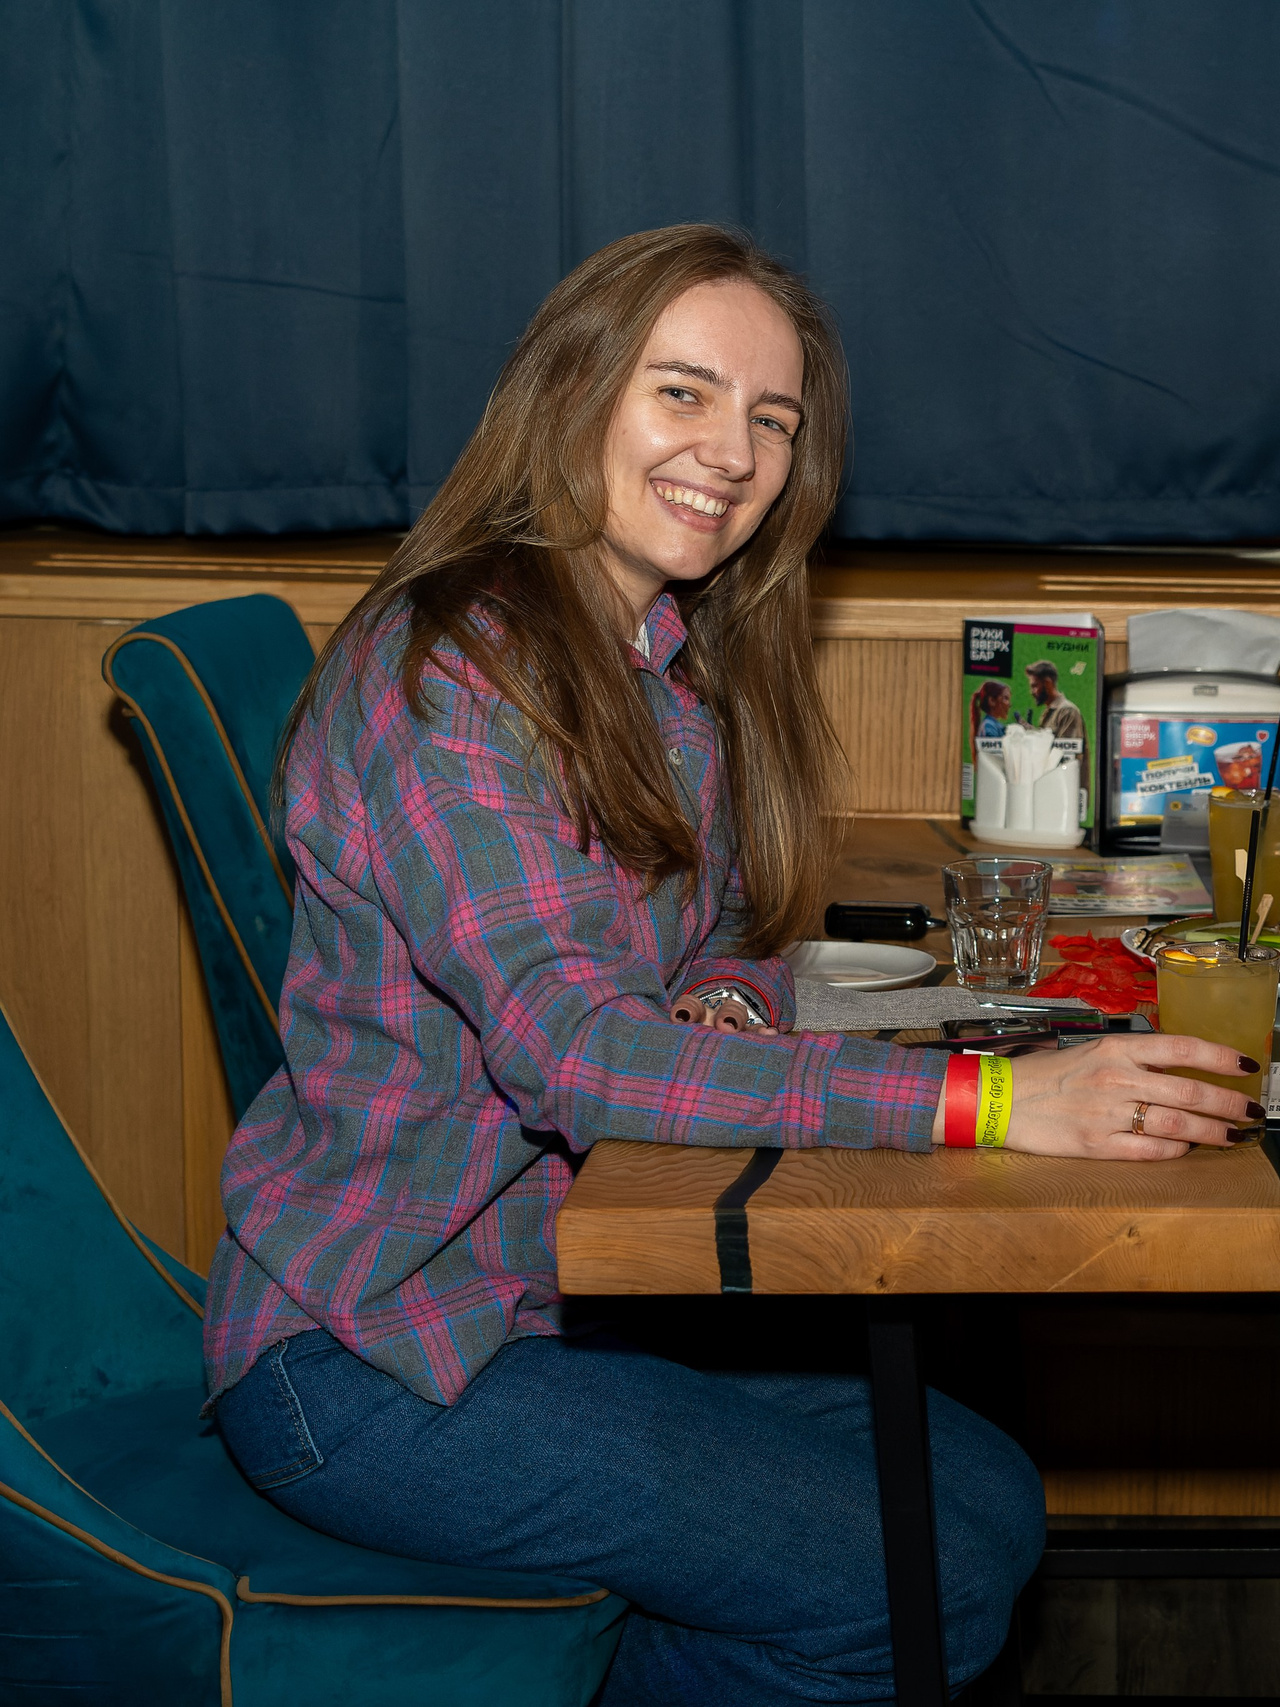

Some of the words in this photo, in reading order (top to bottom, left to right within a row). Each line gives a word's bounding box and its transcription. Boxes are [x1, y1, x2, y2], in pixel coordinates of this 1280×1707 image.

[970, 627, 1003, 640] РУКИ
[970, 638, 1010, 652] ВВЕРХ
[1047, 641, 1089, 652] БУДНИ
[970, 650, 995, 661] БАР
[1140, 777, 1211, 793] КОКТЕЙЛЬ
